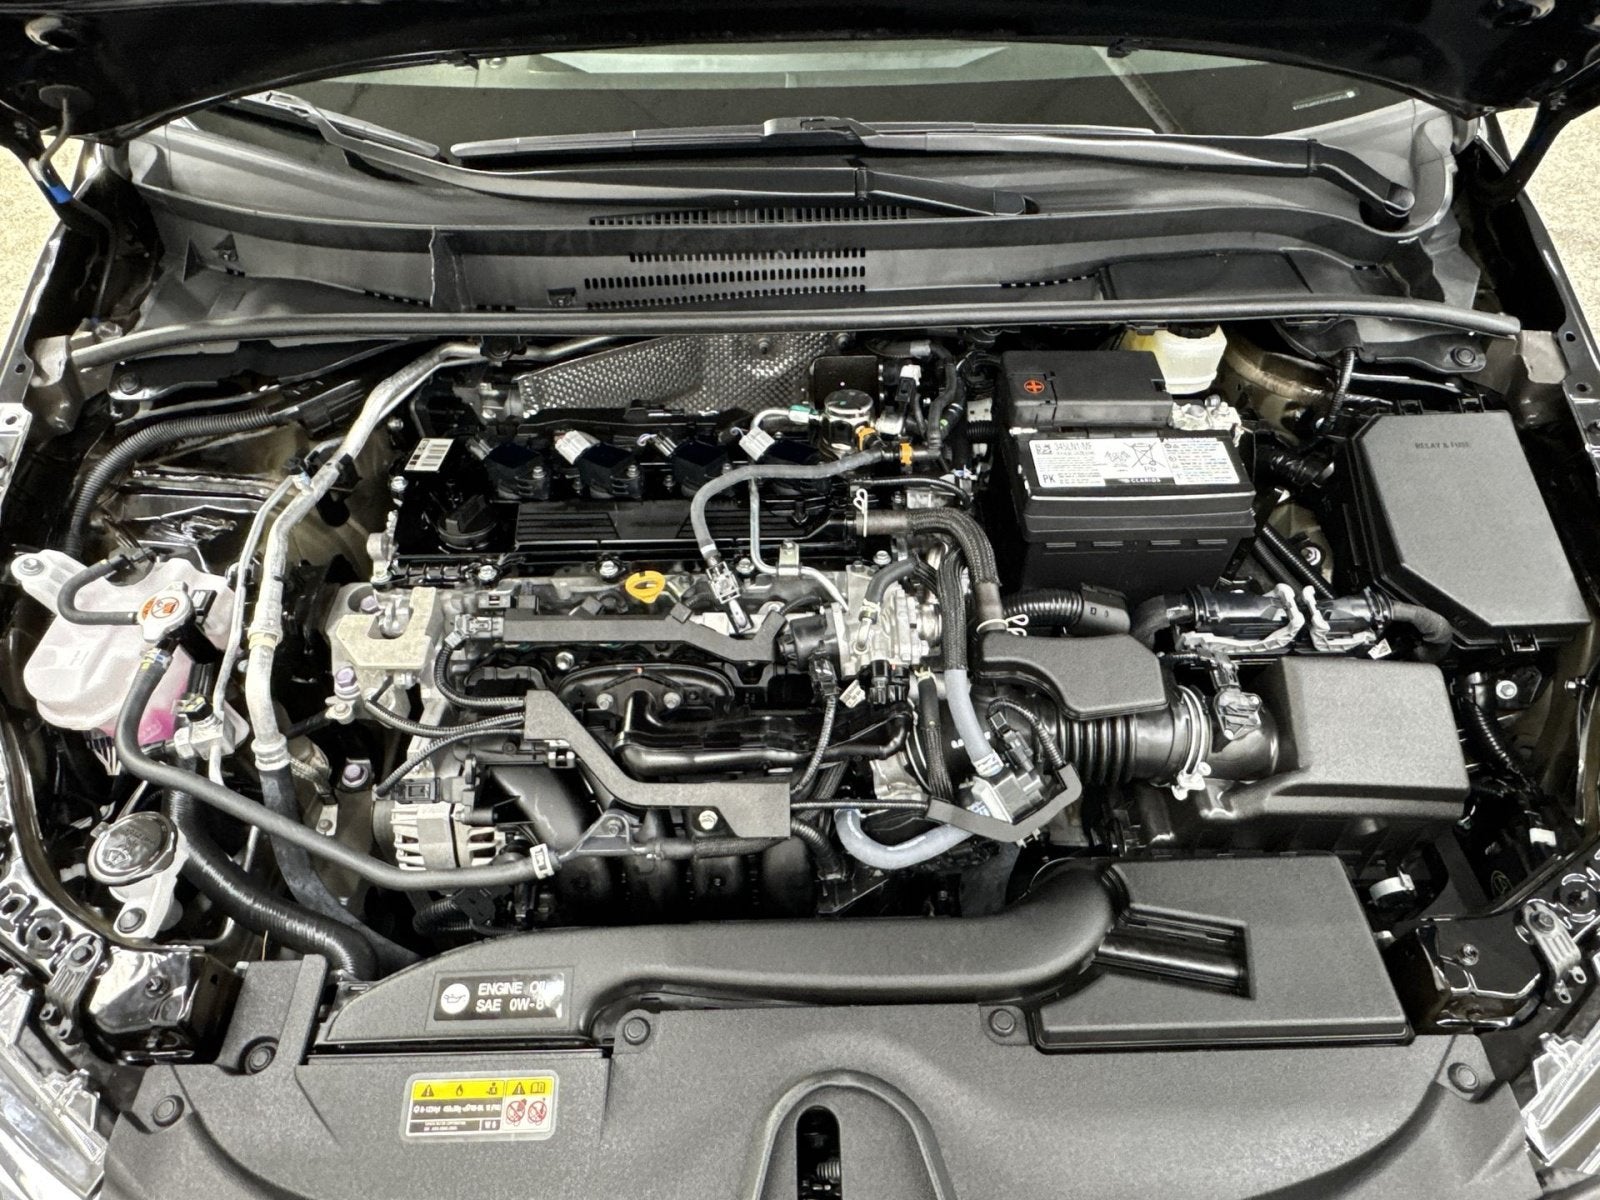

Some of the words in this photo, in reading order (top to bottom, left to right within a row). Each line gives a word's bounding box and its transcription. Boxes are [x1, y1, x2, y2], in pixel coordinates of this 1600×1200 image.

[1042, 474, 1056, 484] PK
[478, 981, 523, 996] ENGINE
[475, 998, 502, 1013] SAE
[509, 997, 545, 1011] 0W-8
